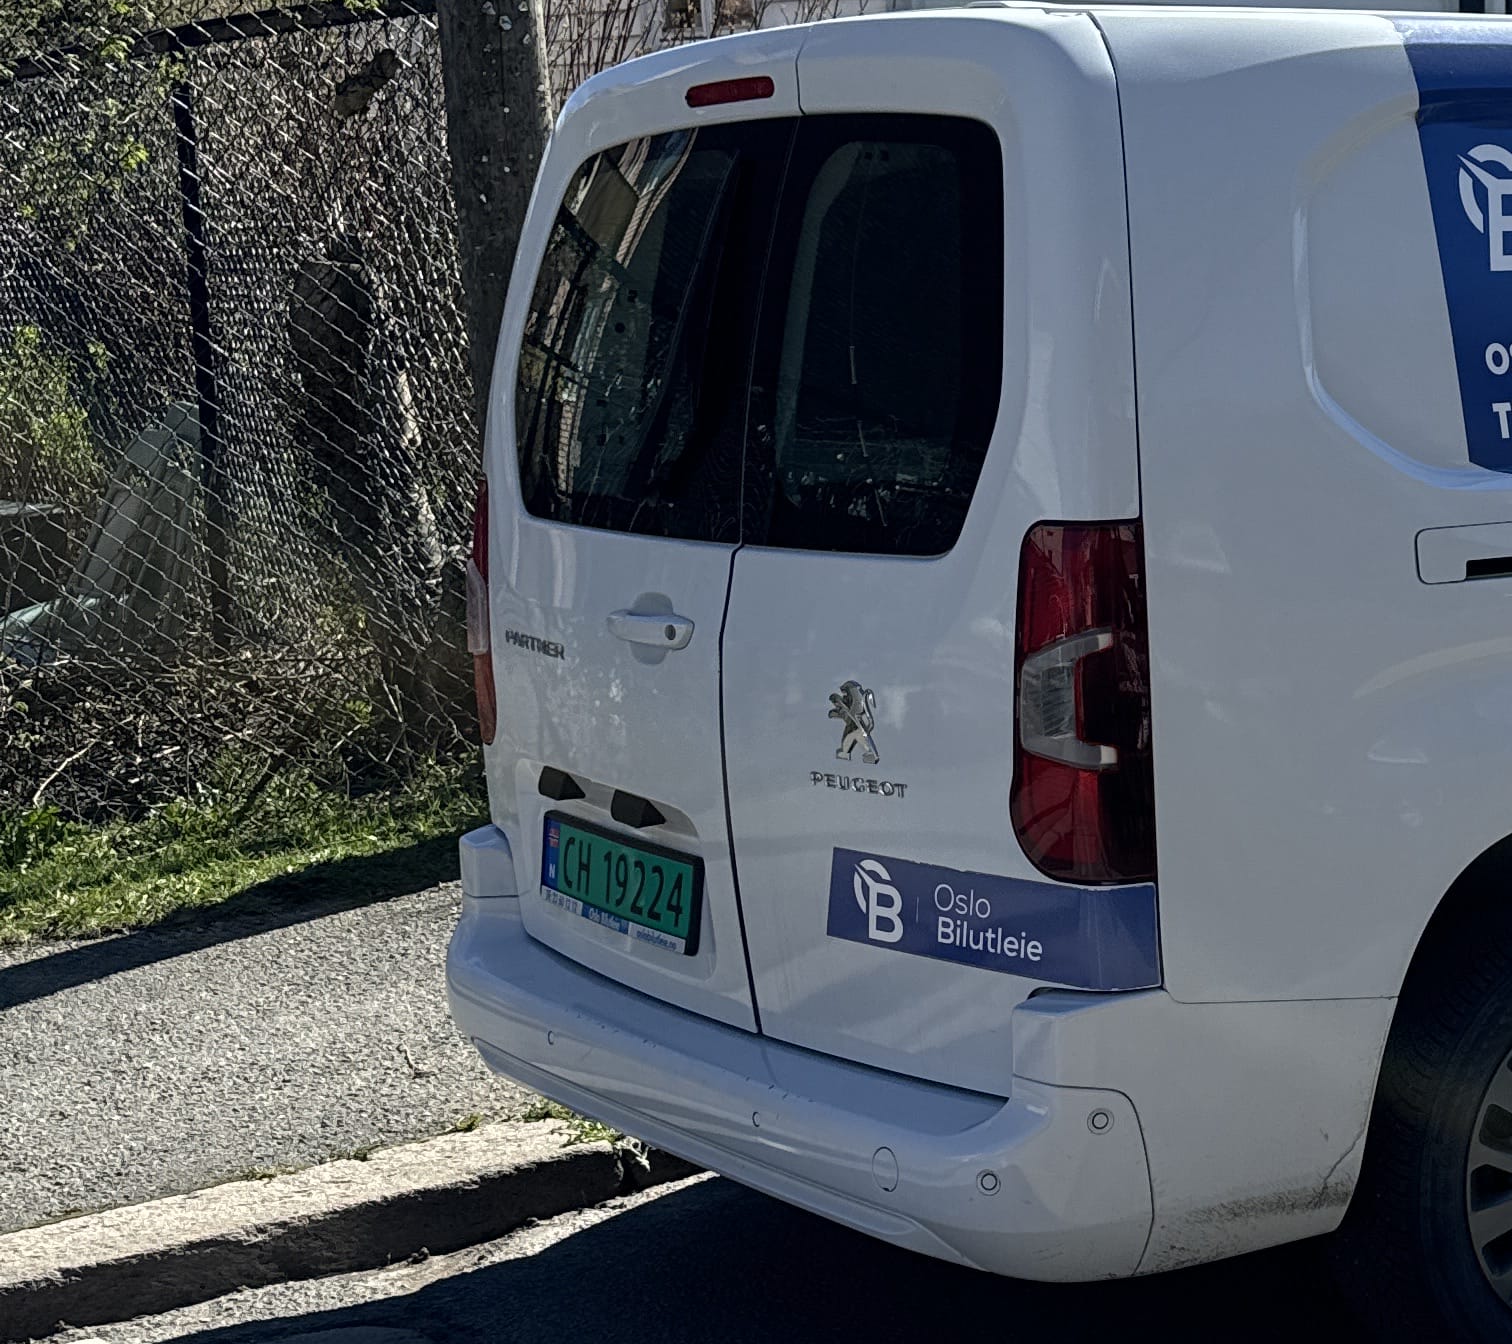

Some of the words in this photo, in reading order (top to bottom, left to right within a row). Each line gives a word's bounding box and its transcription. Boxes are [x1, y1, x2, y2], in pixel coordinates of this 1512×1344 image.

[809, 770, 908, 799] PEUGEOT
[548, 863, 556, 879] N
[563, 836, 592, 897] CH
[603, 850, 684, 928] 19224
[934, 883, 992, 919] Oslo
[937, 916, 1044, 962] Bilutleie
